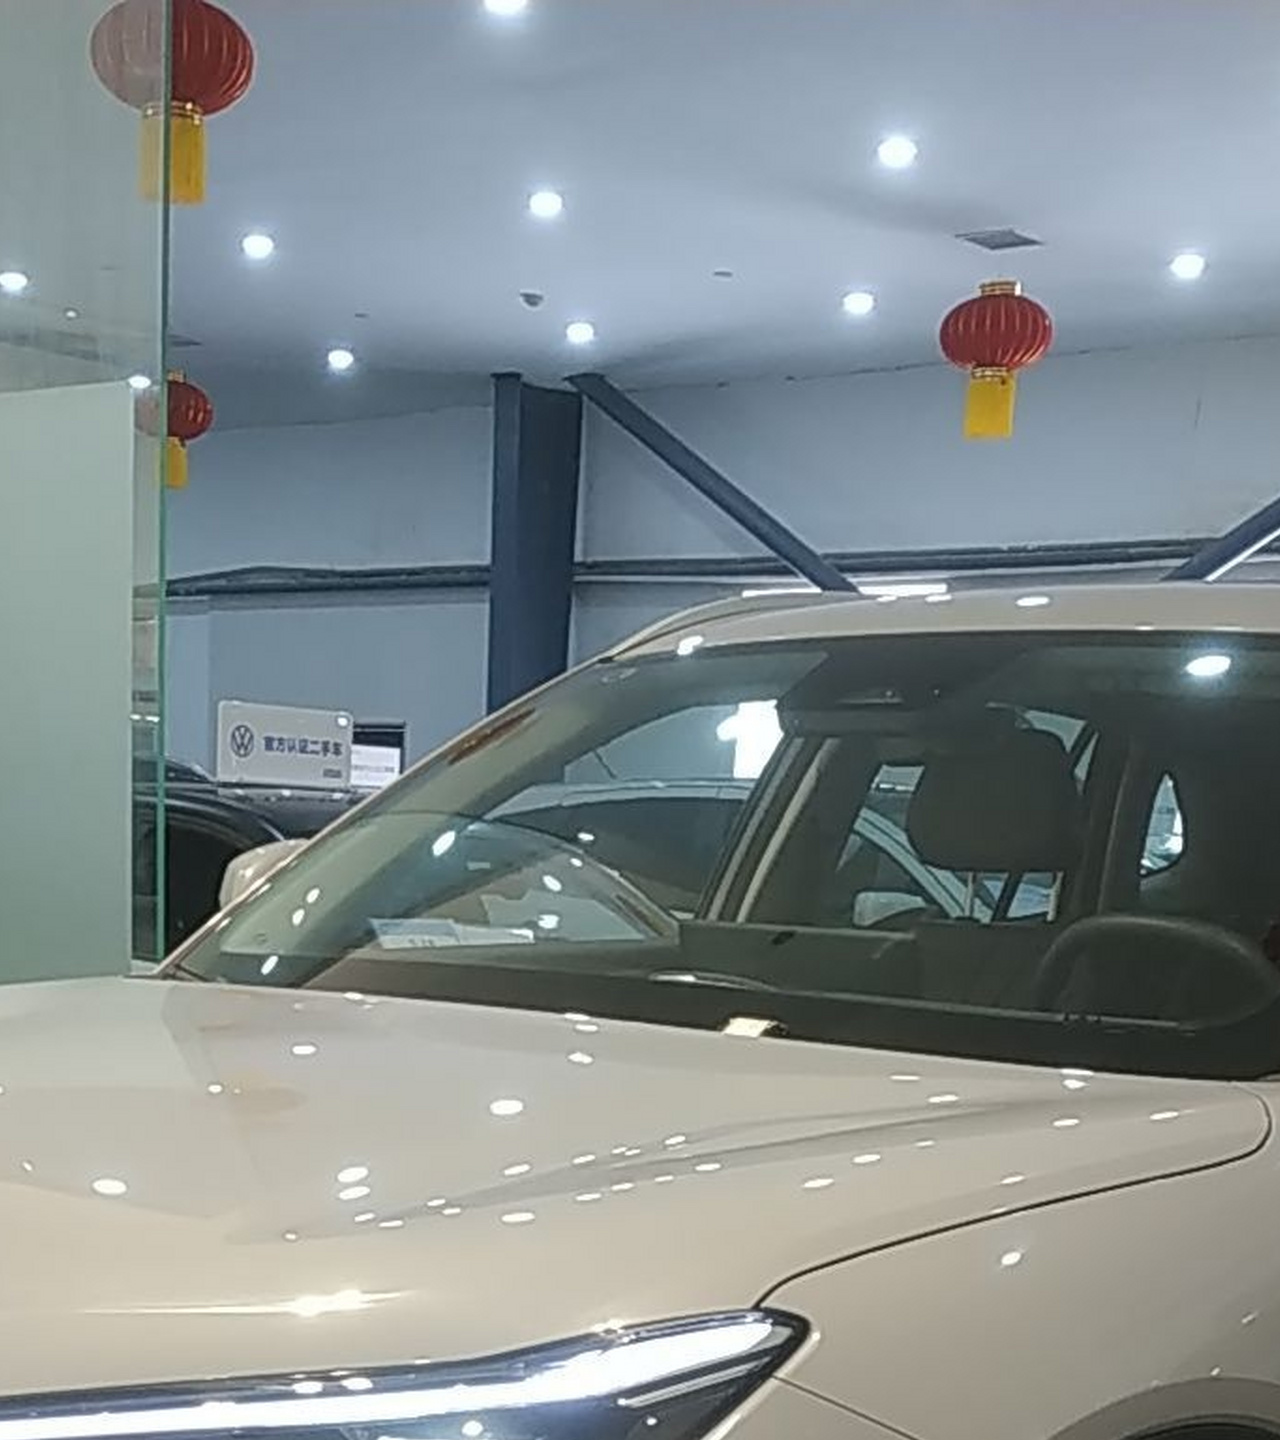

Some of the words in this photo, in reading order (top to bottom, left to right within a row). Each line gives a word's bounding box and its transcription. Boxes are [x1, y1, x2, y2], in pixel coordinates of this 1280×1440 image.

[263, 736, 343, 757] 官方认证二手车
